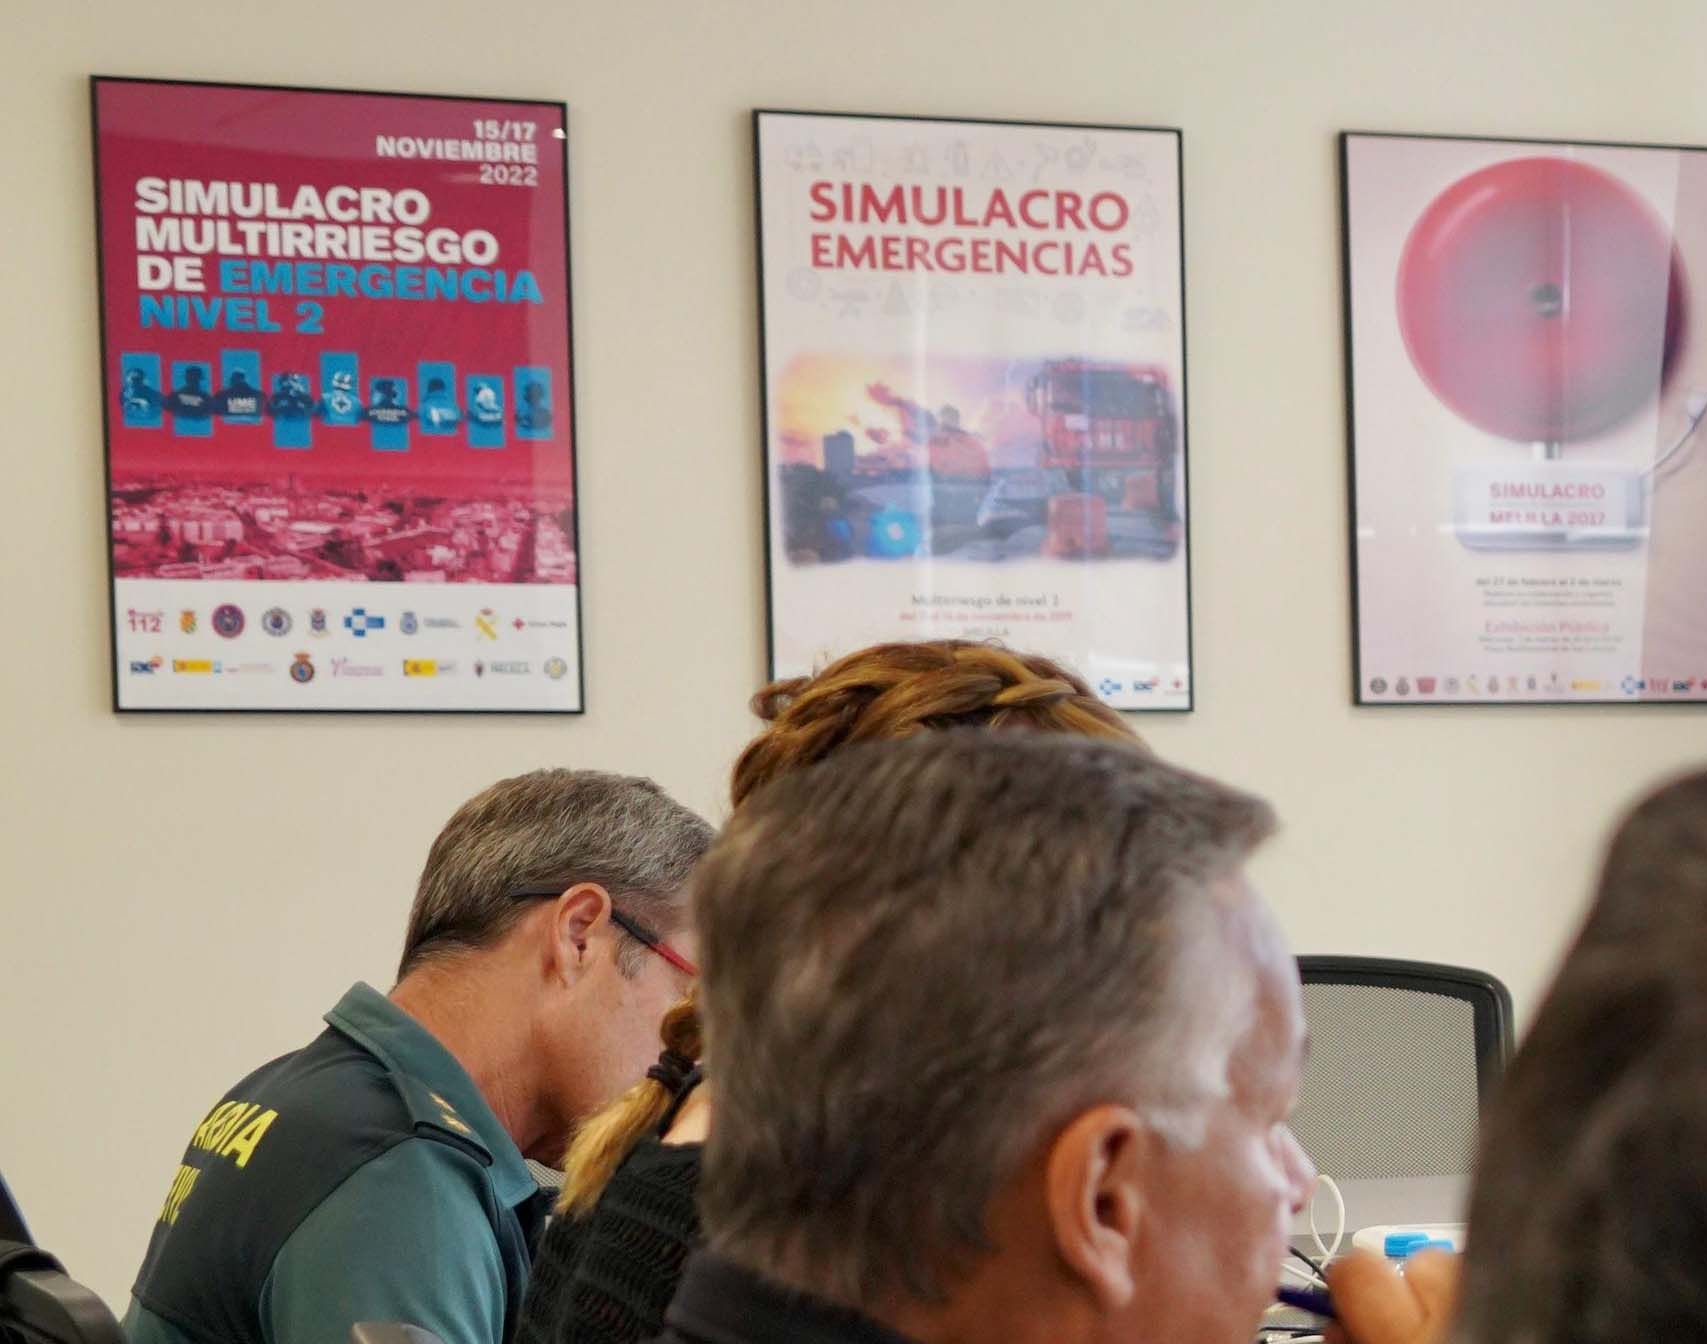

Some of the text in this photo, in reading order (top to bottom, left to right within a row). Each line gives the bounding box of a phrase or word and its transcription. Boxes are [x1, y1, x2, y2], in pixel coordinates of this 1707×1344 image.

[376, 135, 538, 164] NOVIEMBRE
[473, 119, 537, 141] 15/17
[479, 164, 539, 187] 2022
[135, 177, 431, 226] SIMULACRO
[809, 181, 1130, 232] SIMULACRO
[135, 217, 499, 266] MULTIRRIESGO
[810, 233, 1134, 277] EMERGENCIAS
[137, 256, 544, 304] DE EMERGENCIA
[139, 294, 325, 335] NIVEL 2
[1488, 480, 1606, 500] SIMULACRO
